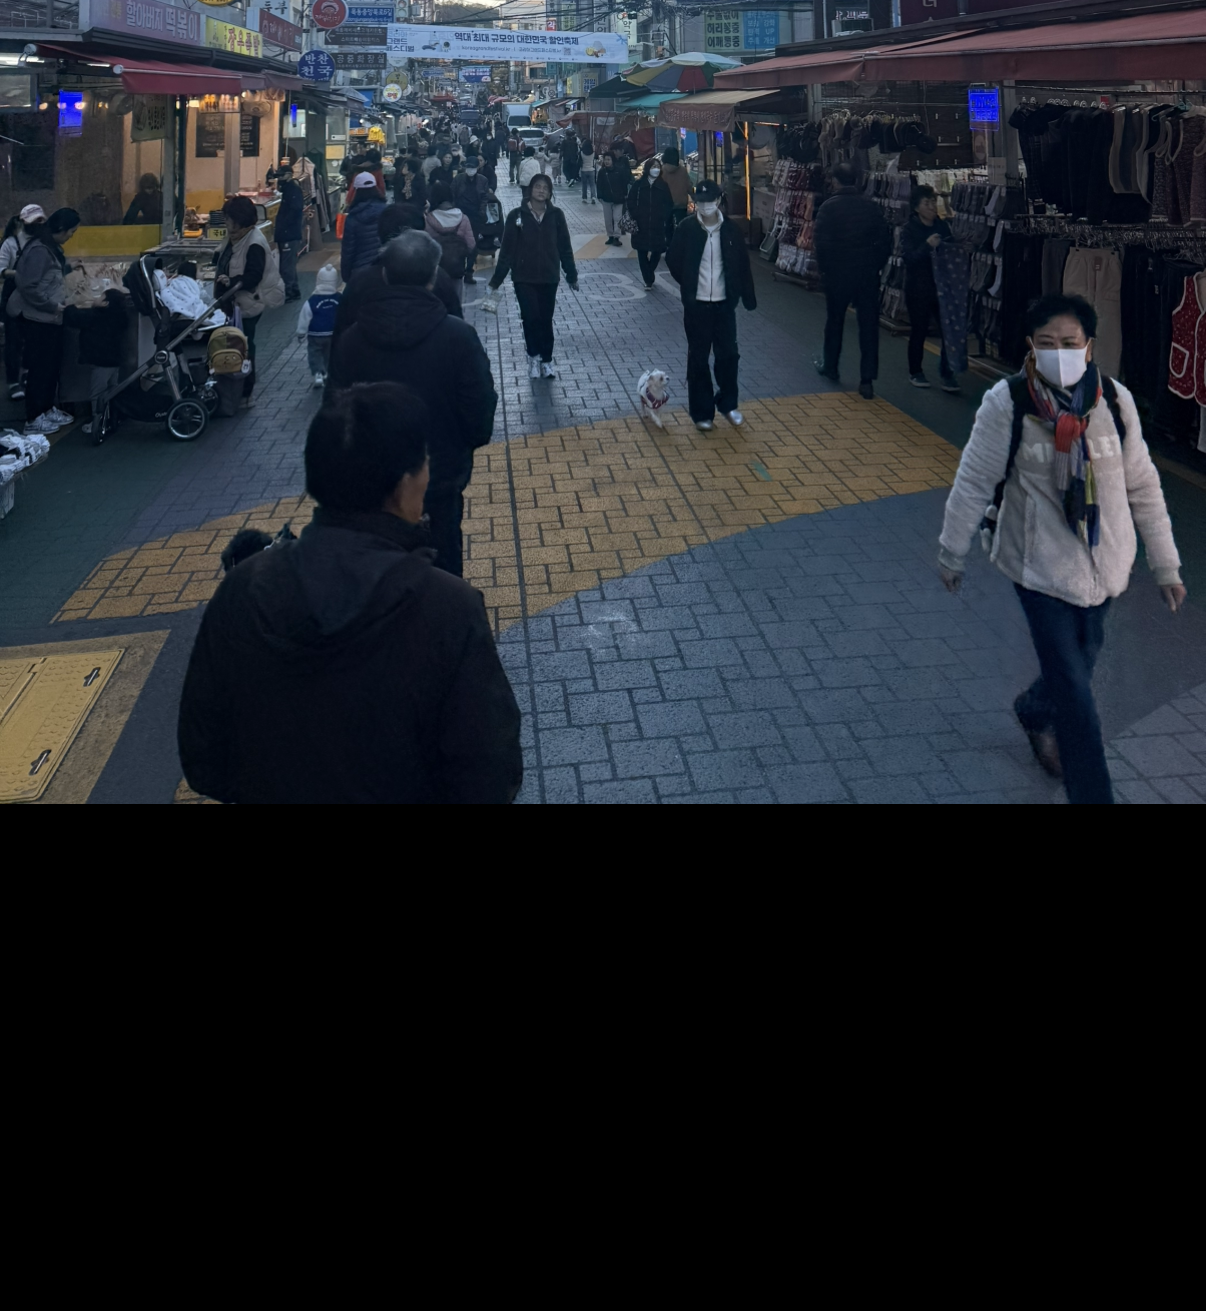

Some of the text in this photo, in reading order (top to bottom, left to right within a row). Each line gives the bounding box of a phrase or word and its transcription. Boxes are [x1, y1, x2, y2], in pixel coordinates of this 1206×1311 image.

[126, 0, 163, 32] 할아버지
[165, 7, 198, 41] 떡볶이
[454, 32, 579, 46] 역대 최대 규모의 대한민국 할인축제
[305, 53, 330, 65] 반찬
[336, 54, 385, 64] 공중화장실
[300, 65, 333, 77] 천국
[1022, 434, 1122, 463] MILET
